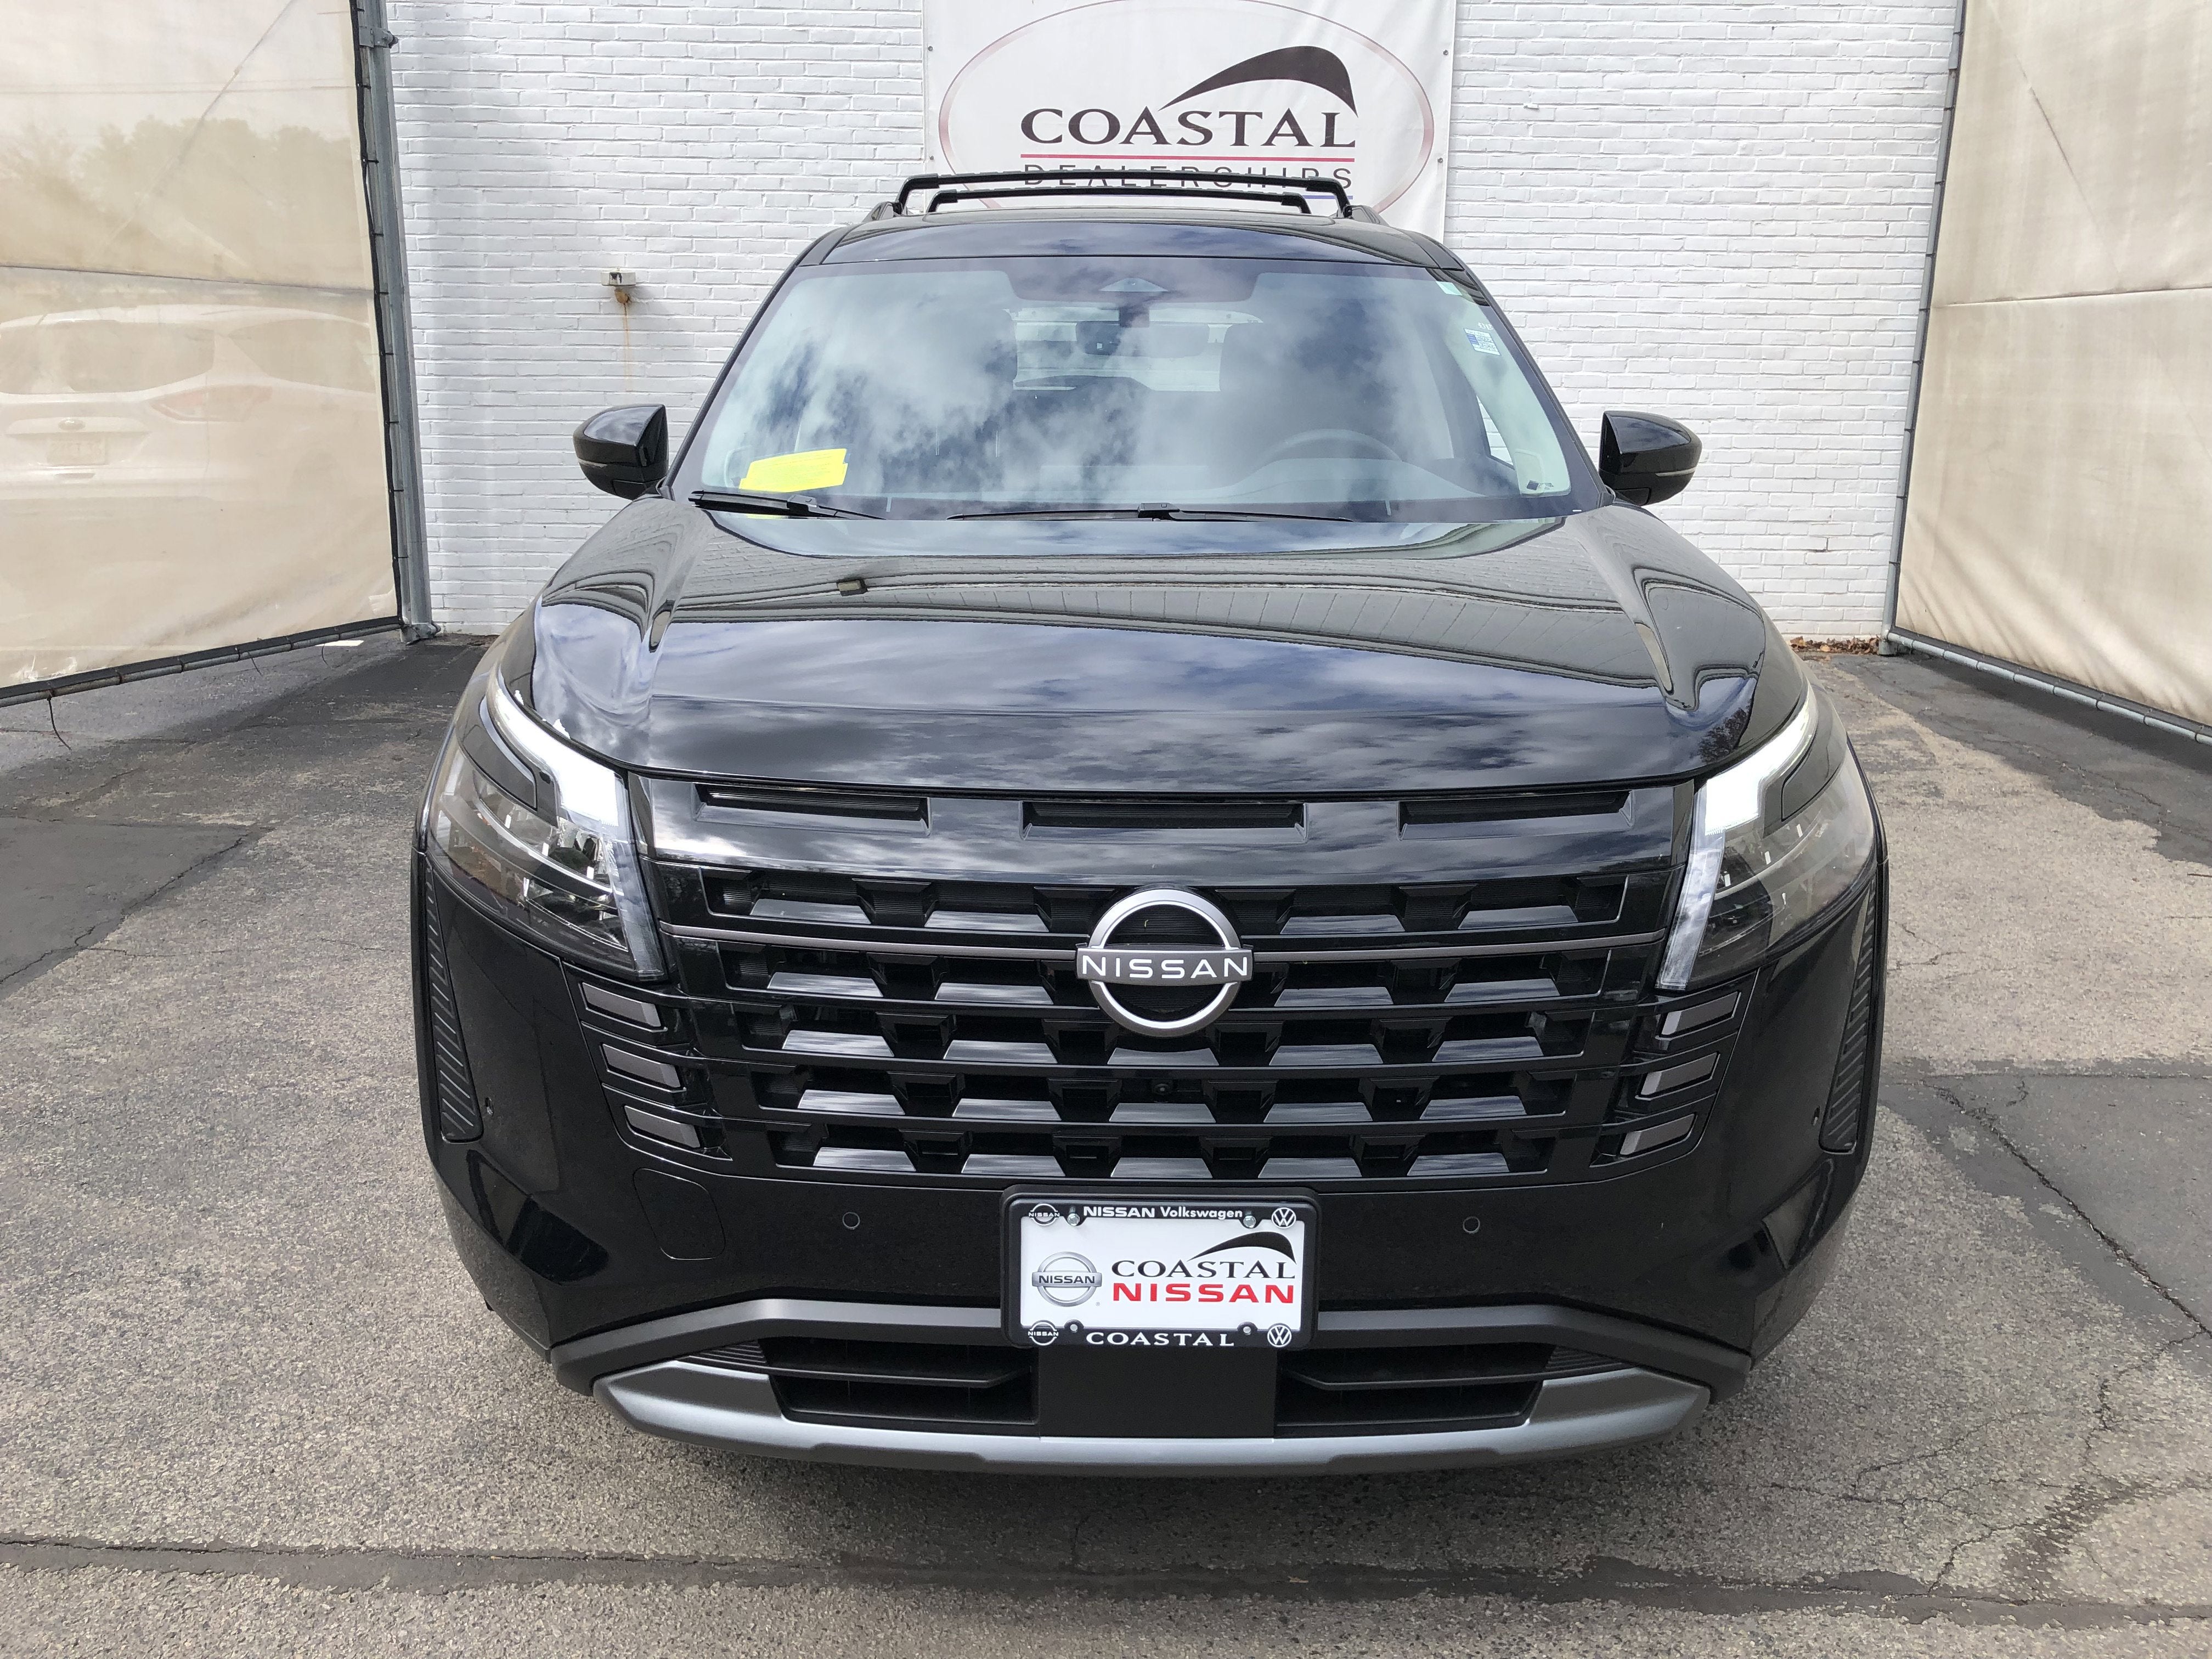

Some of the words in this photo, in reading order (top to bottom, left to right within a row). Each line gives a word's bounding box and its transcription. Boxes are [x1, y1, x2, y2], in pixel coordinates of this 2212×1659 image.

[1020, 106, 1356, 148] COASTAL
[1082, 955, 1248, 979] NISSAN
[1083, 1206, 1155, 1218] NISSAN
[1160, 1206, 1243, 1220] Volkswagen
[1111, 1260, 1296, 1279] COASTAL
[1038, 1274, 1096, 1285] NISSAN
[1113, 1283, 1294, 1304] NISSAN
[1086, 1332, 1235, 1347] COASTAL
